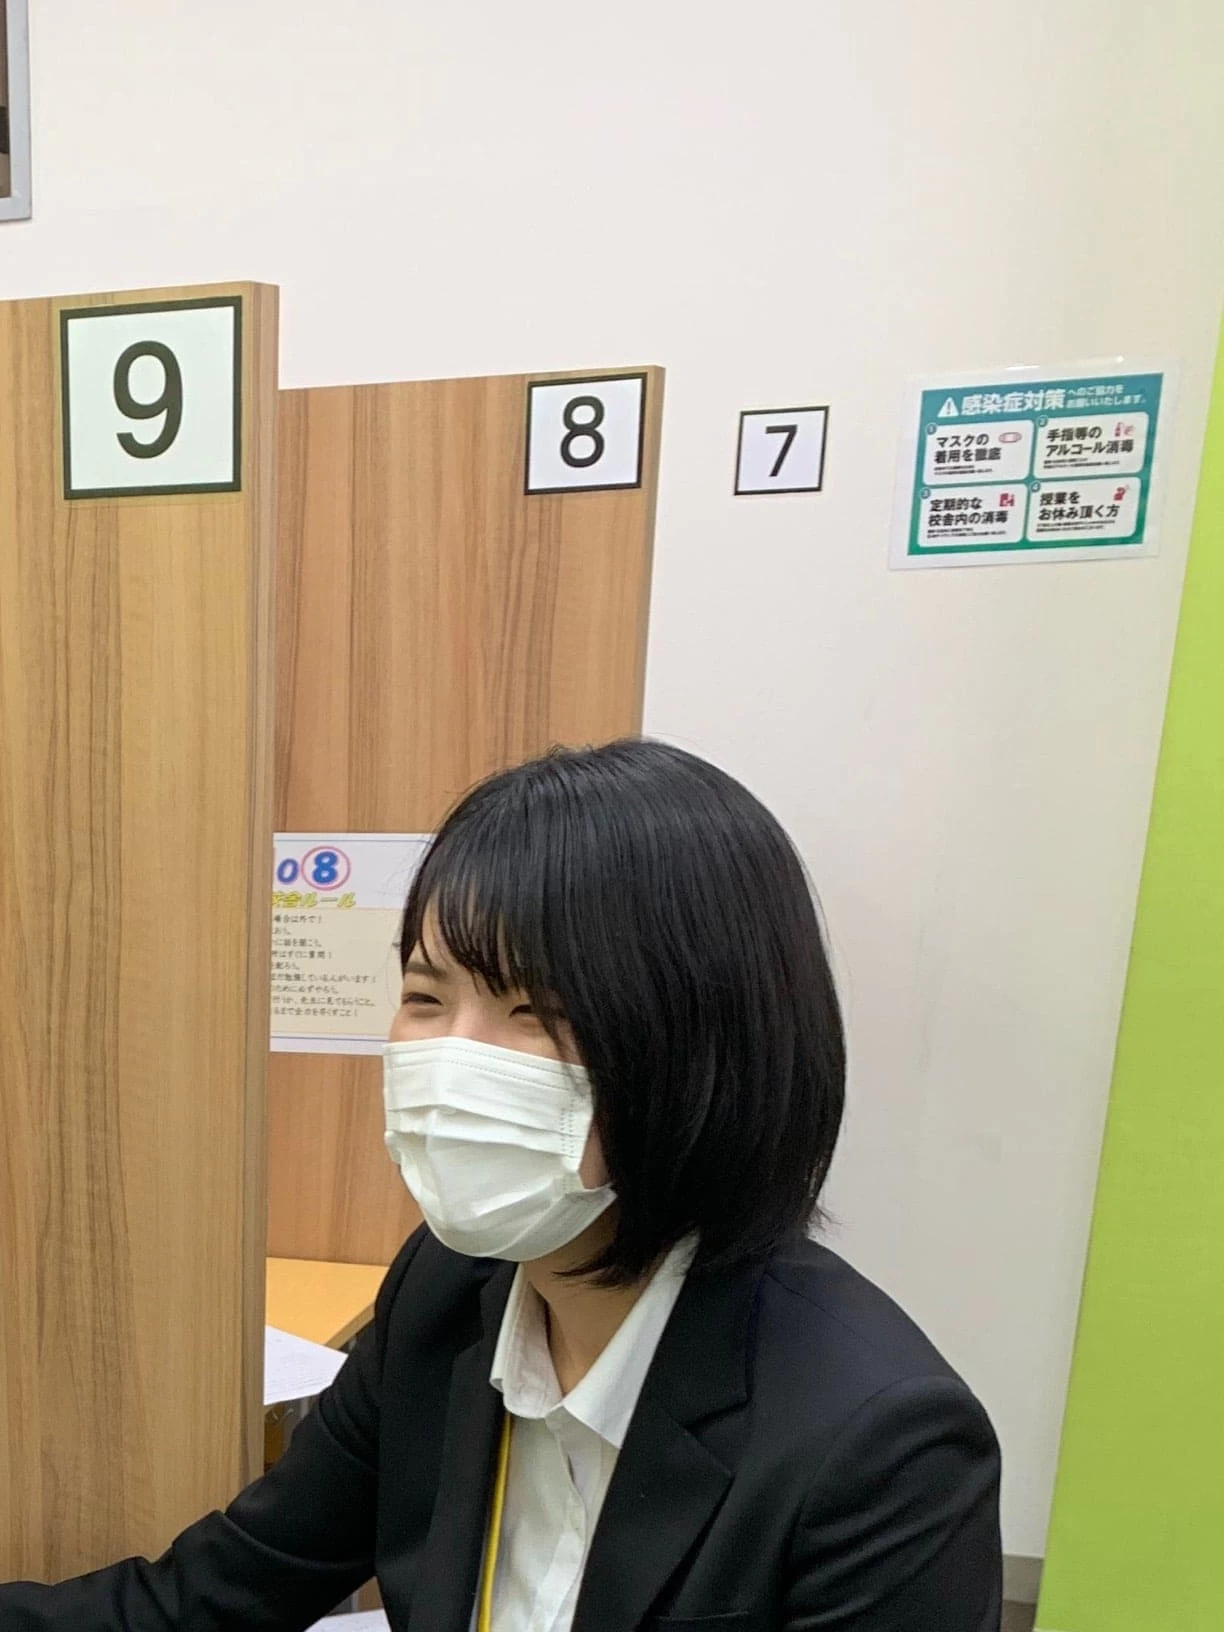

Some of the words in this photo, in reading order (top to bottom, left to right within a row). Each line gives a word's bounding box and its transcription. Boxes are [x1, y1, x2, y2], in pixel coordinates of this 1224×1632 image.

[113, 340, 183, 459] 9
[960, 388, 1066, 416] 感染症対策
[560, 395, 605, 468] 8
[1047, 426, 1102, 442] 手指等の
[936, 434, 989, 448] マスクの
[1045, 439, 1134, 457] アルコール消毒
[764, 424, 798, 477] 7
[934, 447, 1001, 464] 着用を徹底
[930, 497, 982, 512] 定期的な
[1039, 491, 1080, 506] 授業を
[928, 510, 1008, 527] 校舎内の消毒
[1038, 504, 1120, 521] お休み頂く方
[312, 850, 338, 885] 8
